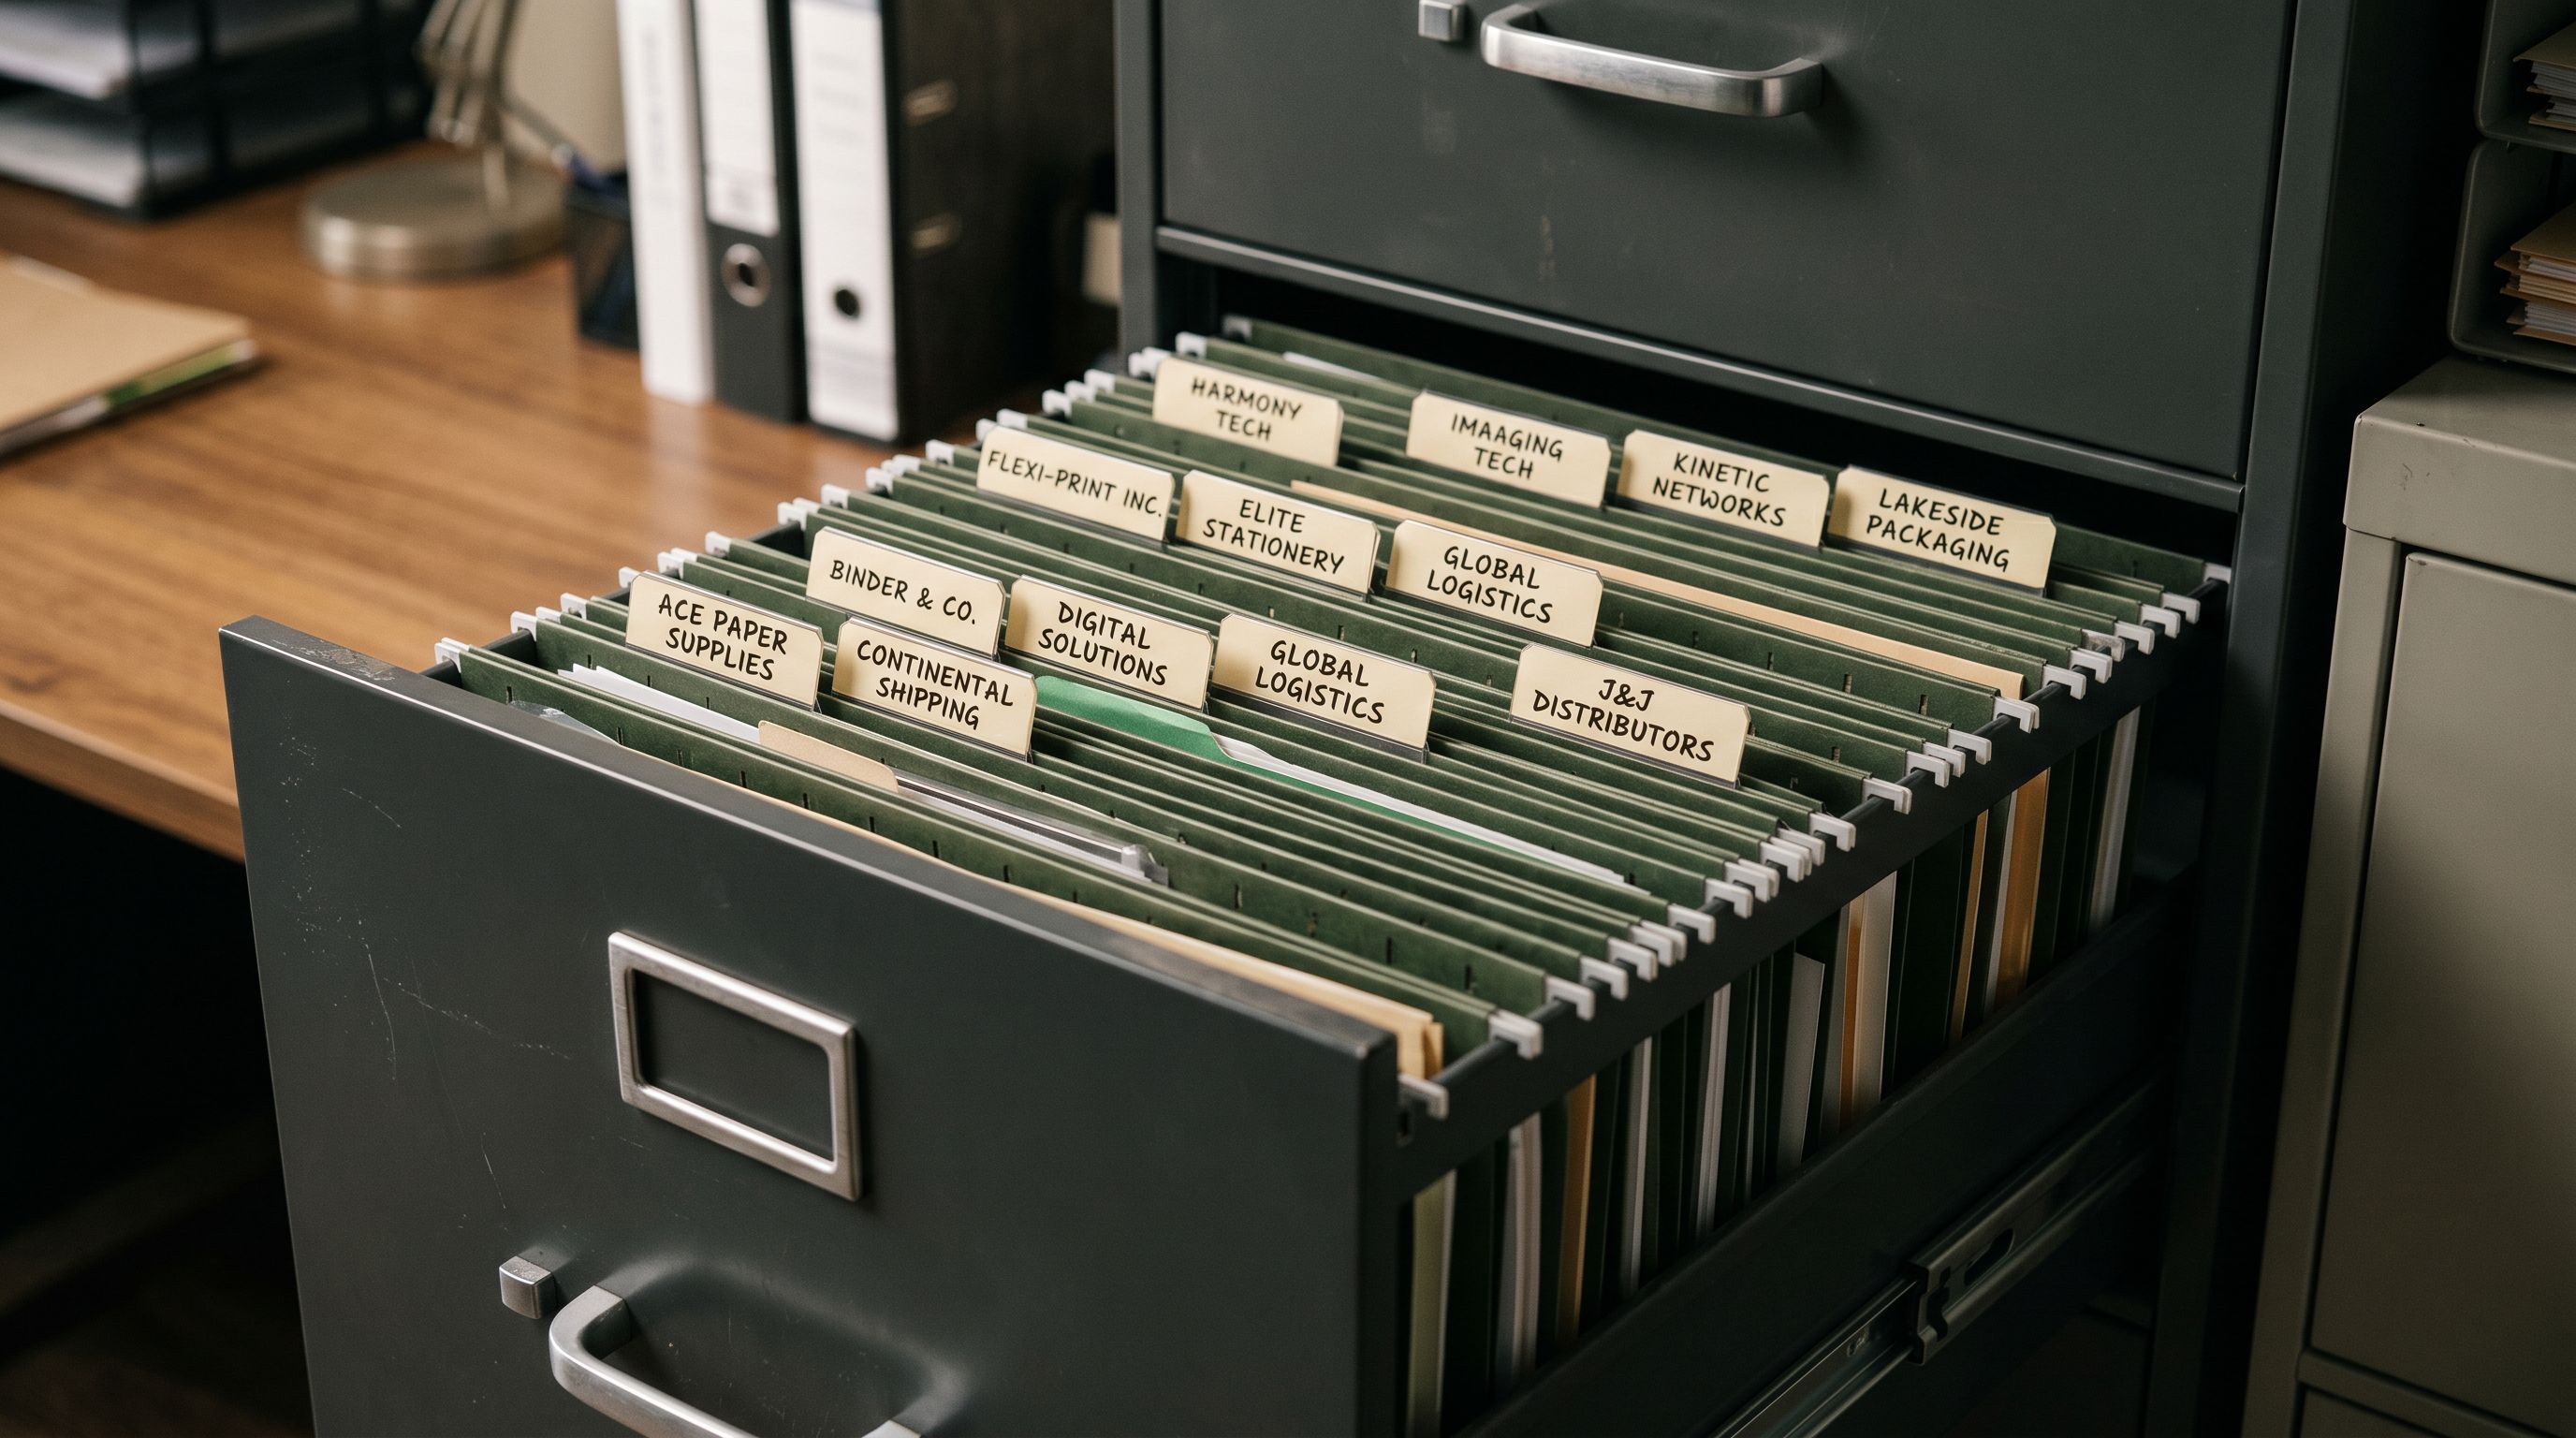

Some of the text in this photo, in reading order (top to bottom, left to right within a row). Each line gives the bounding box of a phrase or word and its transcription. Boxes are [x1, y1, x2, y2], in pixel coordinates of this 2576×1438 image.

[1192, 378, 1302, 419] HARMONY
[1217, 409, 1272, 441] TECH
[1451, 414, 1563, 462] IMAAGING
[988, 449, 1162, 518] FLEXI-PRINT INC.
[1474, 447, 1533, 479] TECH
[1673, 452, 1770, 493] KINETIC
[1239, 498, 1306, 534] ELITE
[1652, 477, 1786, 527] NETWORKS
[1879, 488, 2004, 536] LAKESIDE
[1202, 518, 1345, 575] STATIONERY
[1443, 546, 1540, 590] GLOBAL
[1866, 514, 2010, 573] PACKAGING
[829, 559, 976, 625] BINDER & CO.
[1427, 568, 1553, 624] LOGISTICS
[658, 593, 788, 655] ACE PAPER
[1058, 600, 1151, 650] DIGITAL
[665, 627, 775, 681] SUPPLIES
[856, 639, 1014, 707] CONTINENTAL
[1037, 628, 1168, 686] SOLUTIONS
[1270, 639, 1369, 687] GLOBAL
[875, 677, 979, 731] SHIPPING
[1254, 666, 1385, 725] LOGISTICS
[1598, 679, 1655, 712] J&J
[1532, 689, 1715, 762] DISTRIBUTORS
